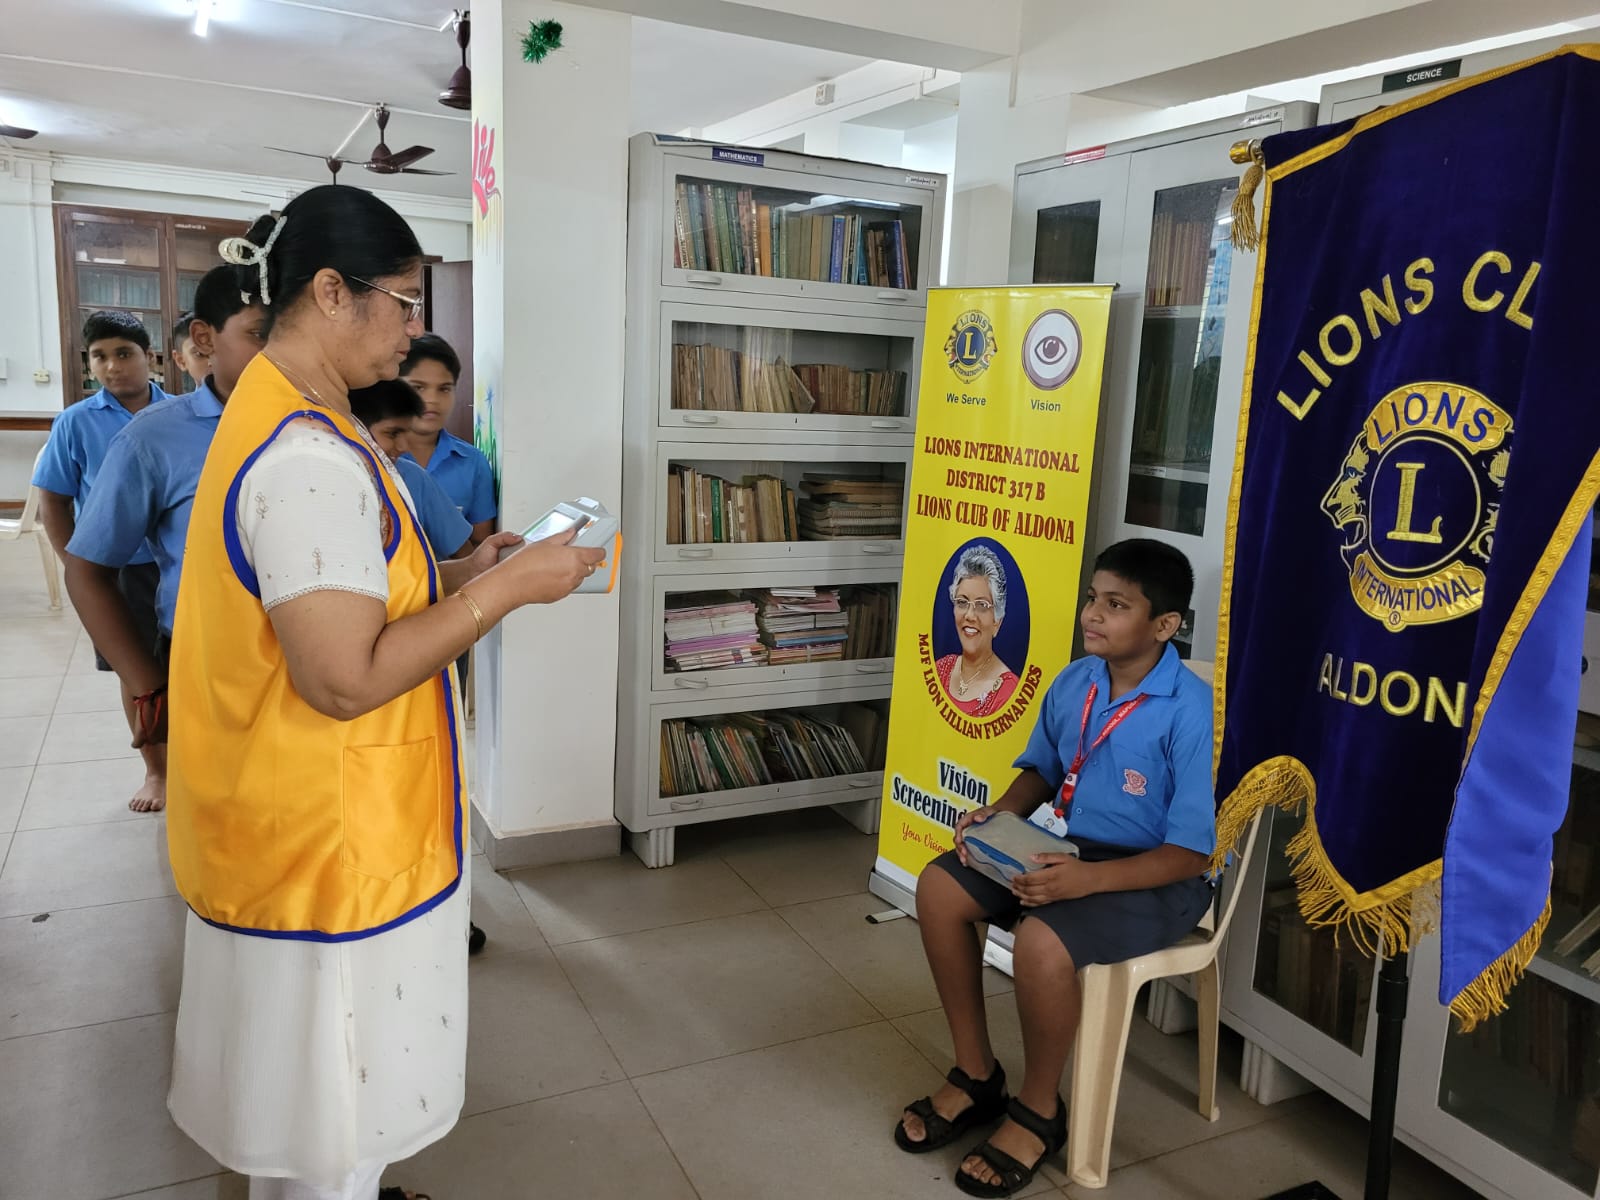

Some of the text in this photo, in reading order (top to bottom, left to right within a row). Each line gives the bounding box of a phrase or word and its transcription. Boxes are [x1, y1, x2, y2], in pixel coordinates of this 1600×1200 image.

[1406, 67, 1442, 83] SCIENCE
[719, 151, 758, 162] MATHEMATICS
[960, 313, 987, 329] LIONS
[1276, 257, 1435, 420] LIONS
[963, 332, 977, 359] L
[946, 392, 986, 406] We Serve
[1030, 399, 1061, 412] Vision
[1373, 392, 1495, 446] LIONS
[924, 436, 1080, 473] LIONS INTERNATIONAL
[946, 468, 1046, 502] DISTRICT 317 B
[1386, 462, 1443, 544] L
[916, 494, 1075, 545] LIONS CLUB OF ALDONA
[1356, 561, 1481, 611] INTERNATIONAL
[918, 633, 931, 666] MJF
[923, 668, 944, 707] LION
[983, 664, 1043, 740] FERNANDES
[939, 702, 983, 740] LILLIAN
[939, 761, 988, 806] Vision
[902, 822, 922, 843] Your
